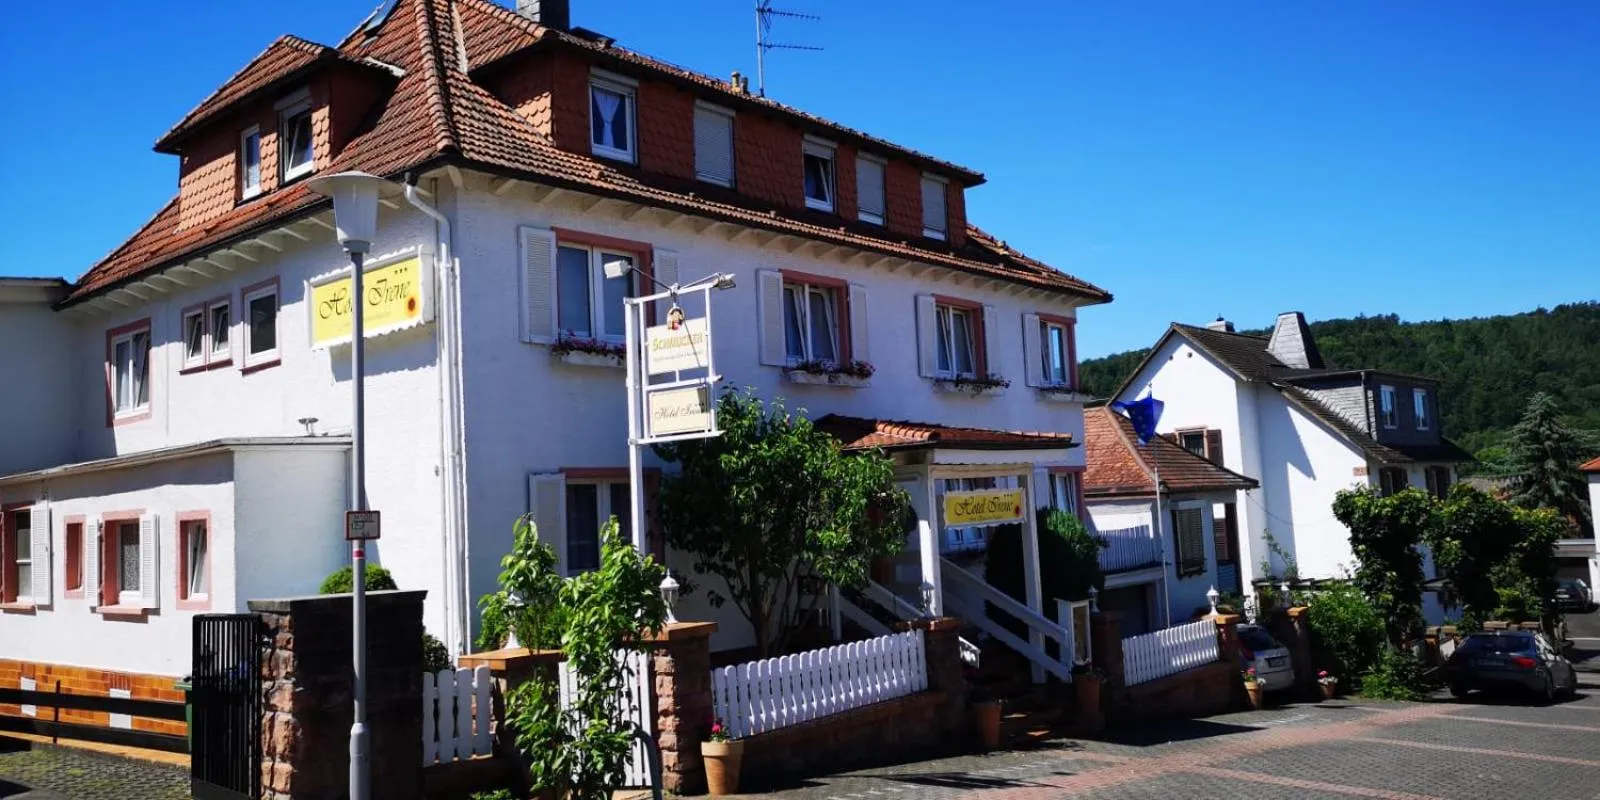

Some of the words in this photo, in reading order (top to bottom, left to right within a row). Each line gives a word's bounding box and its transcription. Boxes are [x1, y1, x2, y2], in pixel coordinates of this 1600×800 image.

[368, 277, 411, 306] Irene
[954, 496, 986, 516] Hotel
[987, 496, 1013, 513] Irene
